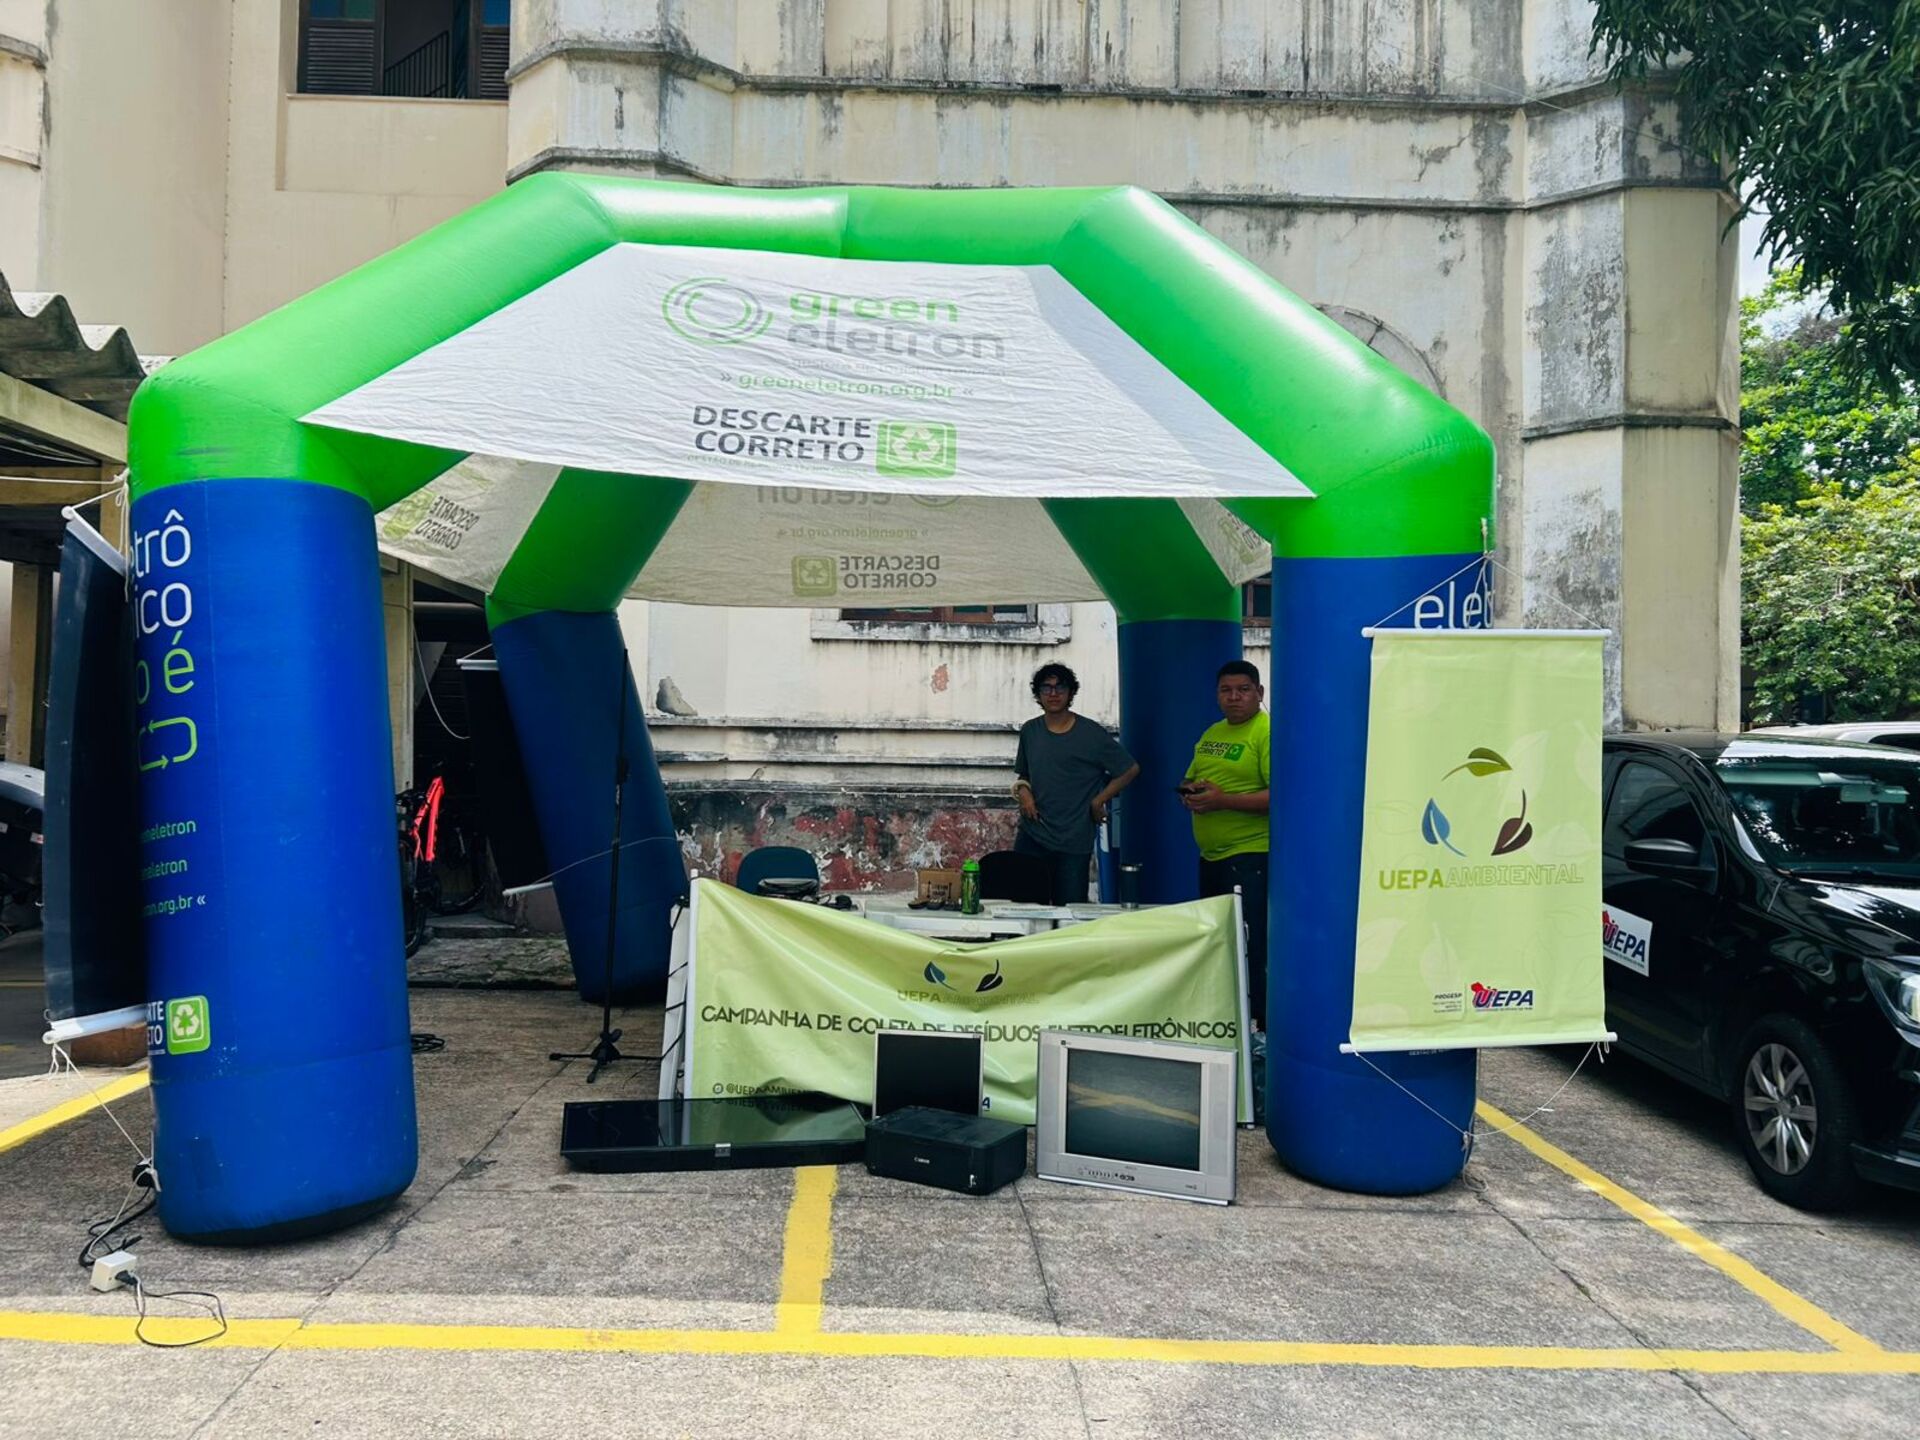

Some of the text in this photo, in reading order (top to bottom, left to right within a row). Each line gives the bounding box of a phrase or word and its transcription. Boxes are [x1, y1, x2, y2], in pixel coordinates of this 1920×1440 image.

[788, 292, 960, 322] green
[787, 318, 1005, 359] eletron
[738, 373, 957, 400] greeneletron.org.br
[692, 405, 872, 438] DESCARTE
[695, 430, 864, 462] CORRETO
[134, 582, 192, 638] ico
[163, 630, 195, 694] é
[701, 1005, 812, 1030] CAMPANHA
[816, 1014, 842, 1031] DE
